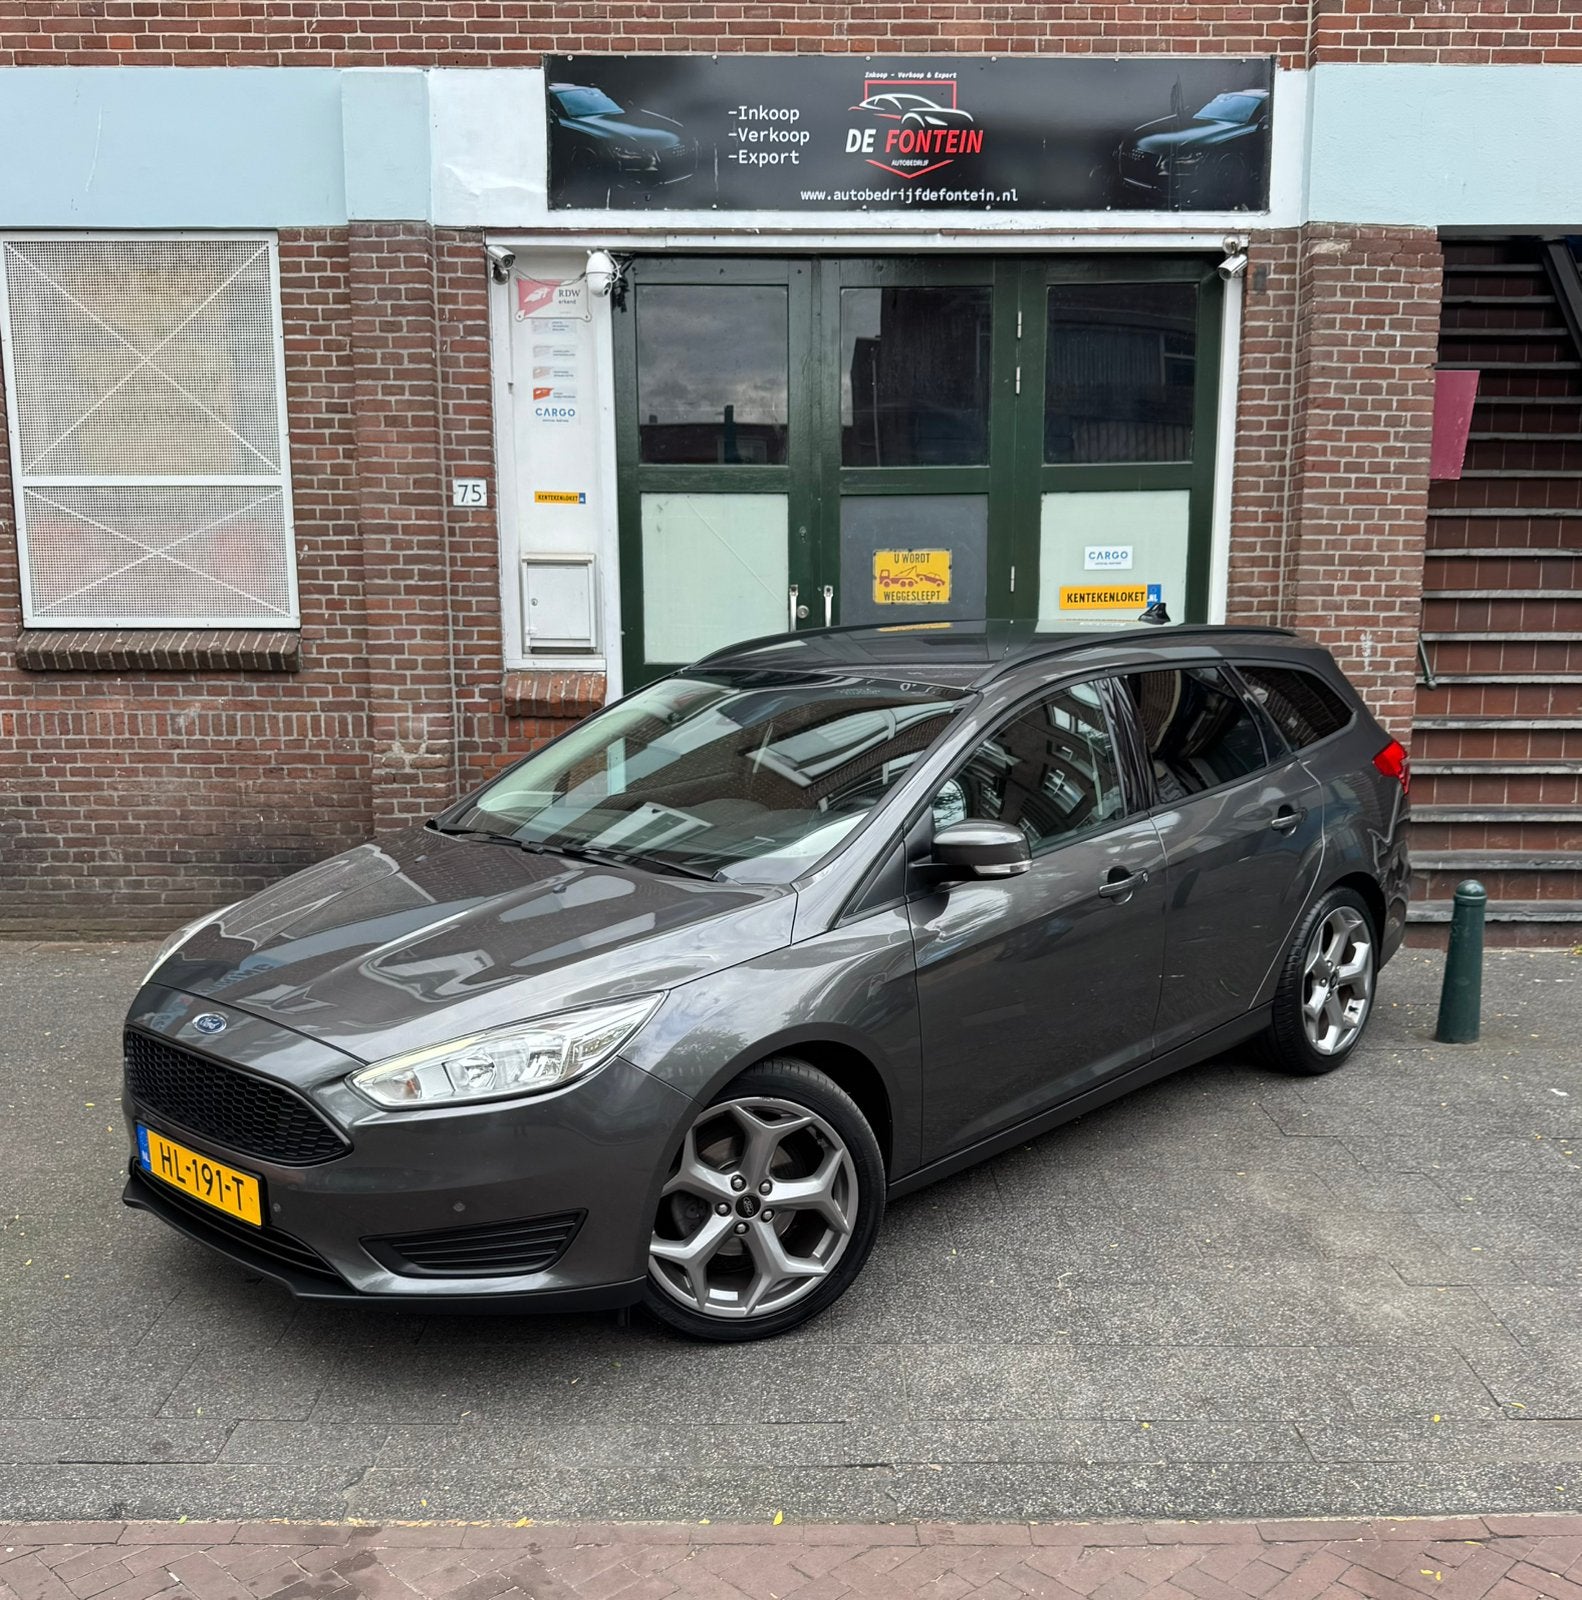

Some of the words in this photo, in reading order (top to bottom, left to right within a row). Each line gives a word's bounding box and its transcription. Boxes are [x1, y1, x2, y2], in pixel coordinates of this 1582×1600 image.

[728, 105, 800, 122] -Inkoop
[728, 127, 810, 144] -Verkoop
[845, 128, 876, 153] DE
[884, 129, 983, 153] FONTEIN
[728, 149, 800, 167] -Export
[800, 187, 1018, 204] www.autobedrijfdefontein.nl
[558, 289, 581, 297] RDW
[535, 408, 576, 417] CARGO
[457, 485, 482, 502] 75
[894, 553, 900, 563] U
[902, 553, 930, 563] WORDT
[1088, 551, 1129, 560] CARGO
[883, 590, 941, 601] WEGGESLEEPT
[1066, 591, 1146, 603] KENTEKENLOKET
[159, 1142, 245, 1211] HL-191-T
